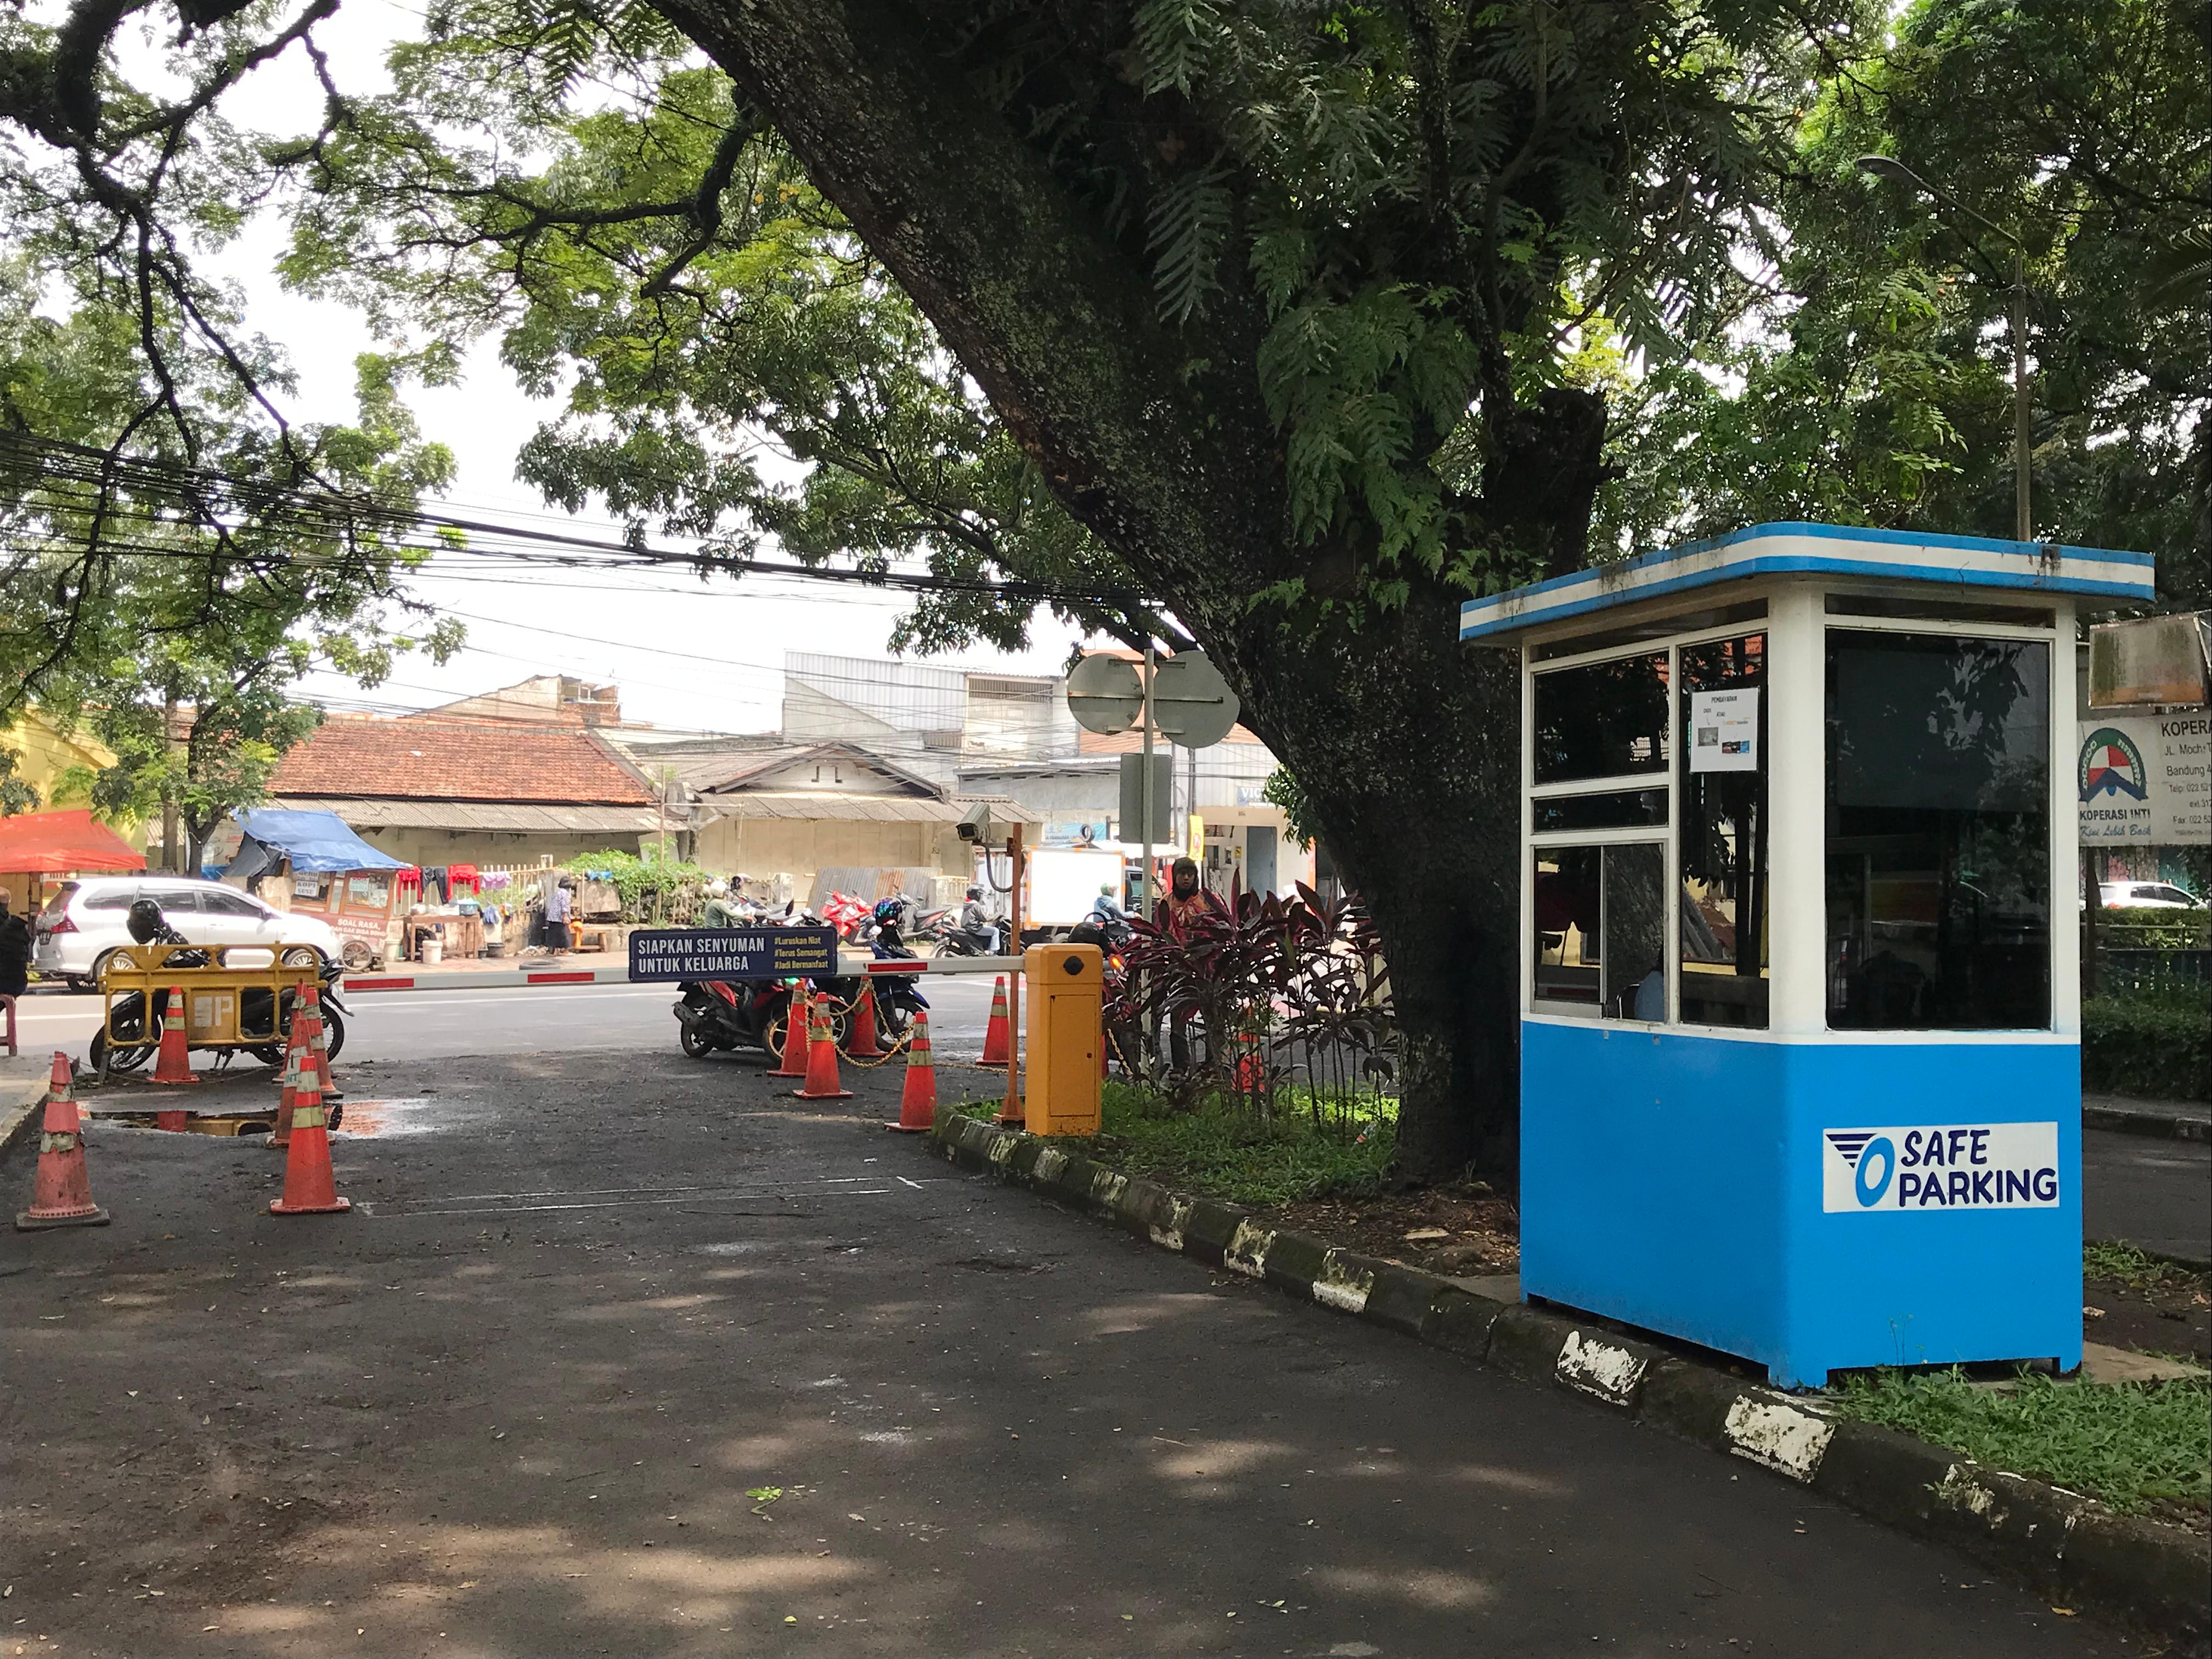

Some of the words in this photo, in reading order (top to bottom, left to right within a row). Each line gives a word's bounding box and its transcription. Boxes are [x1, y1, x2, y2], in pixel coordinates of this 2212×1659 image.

[2166, 765, 2205, 777] Bandung
[2079, 809, 2128, 821] KOPERASI
[2130, 808, 2151, 819] INTI
[2102, 825, 2126, 836] Lebih
[2129, 824, 2151, 836] Baik
[337, 918, 358, 927] SOAL
[358, 921, 381, 930] RASA,
[638, 938, 693, 955] SIAPKAN
[697, 936, 765, 953] SENYUMAN
[774, 936, 807, 945] #Luruskan
[808, 935, 821, 944] Niat
[774, 949, 796, 957] #Terus
[796, 948, 828, 958] Semangat
[639, 957, 681, 974] UNTUK
[685, 956, 749, 972] KELUARGA
[774, 961, 791, 969] #Jadi
[792, 960, 828, 969] Bermanfaat
[1900, 1129, 1991, 1167] SAFE
[1899, 1167, 2057, 1207] PARKING
